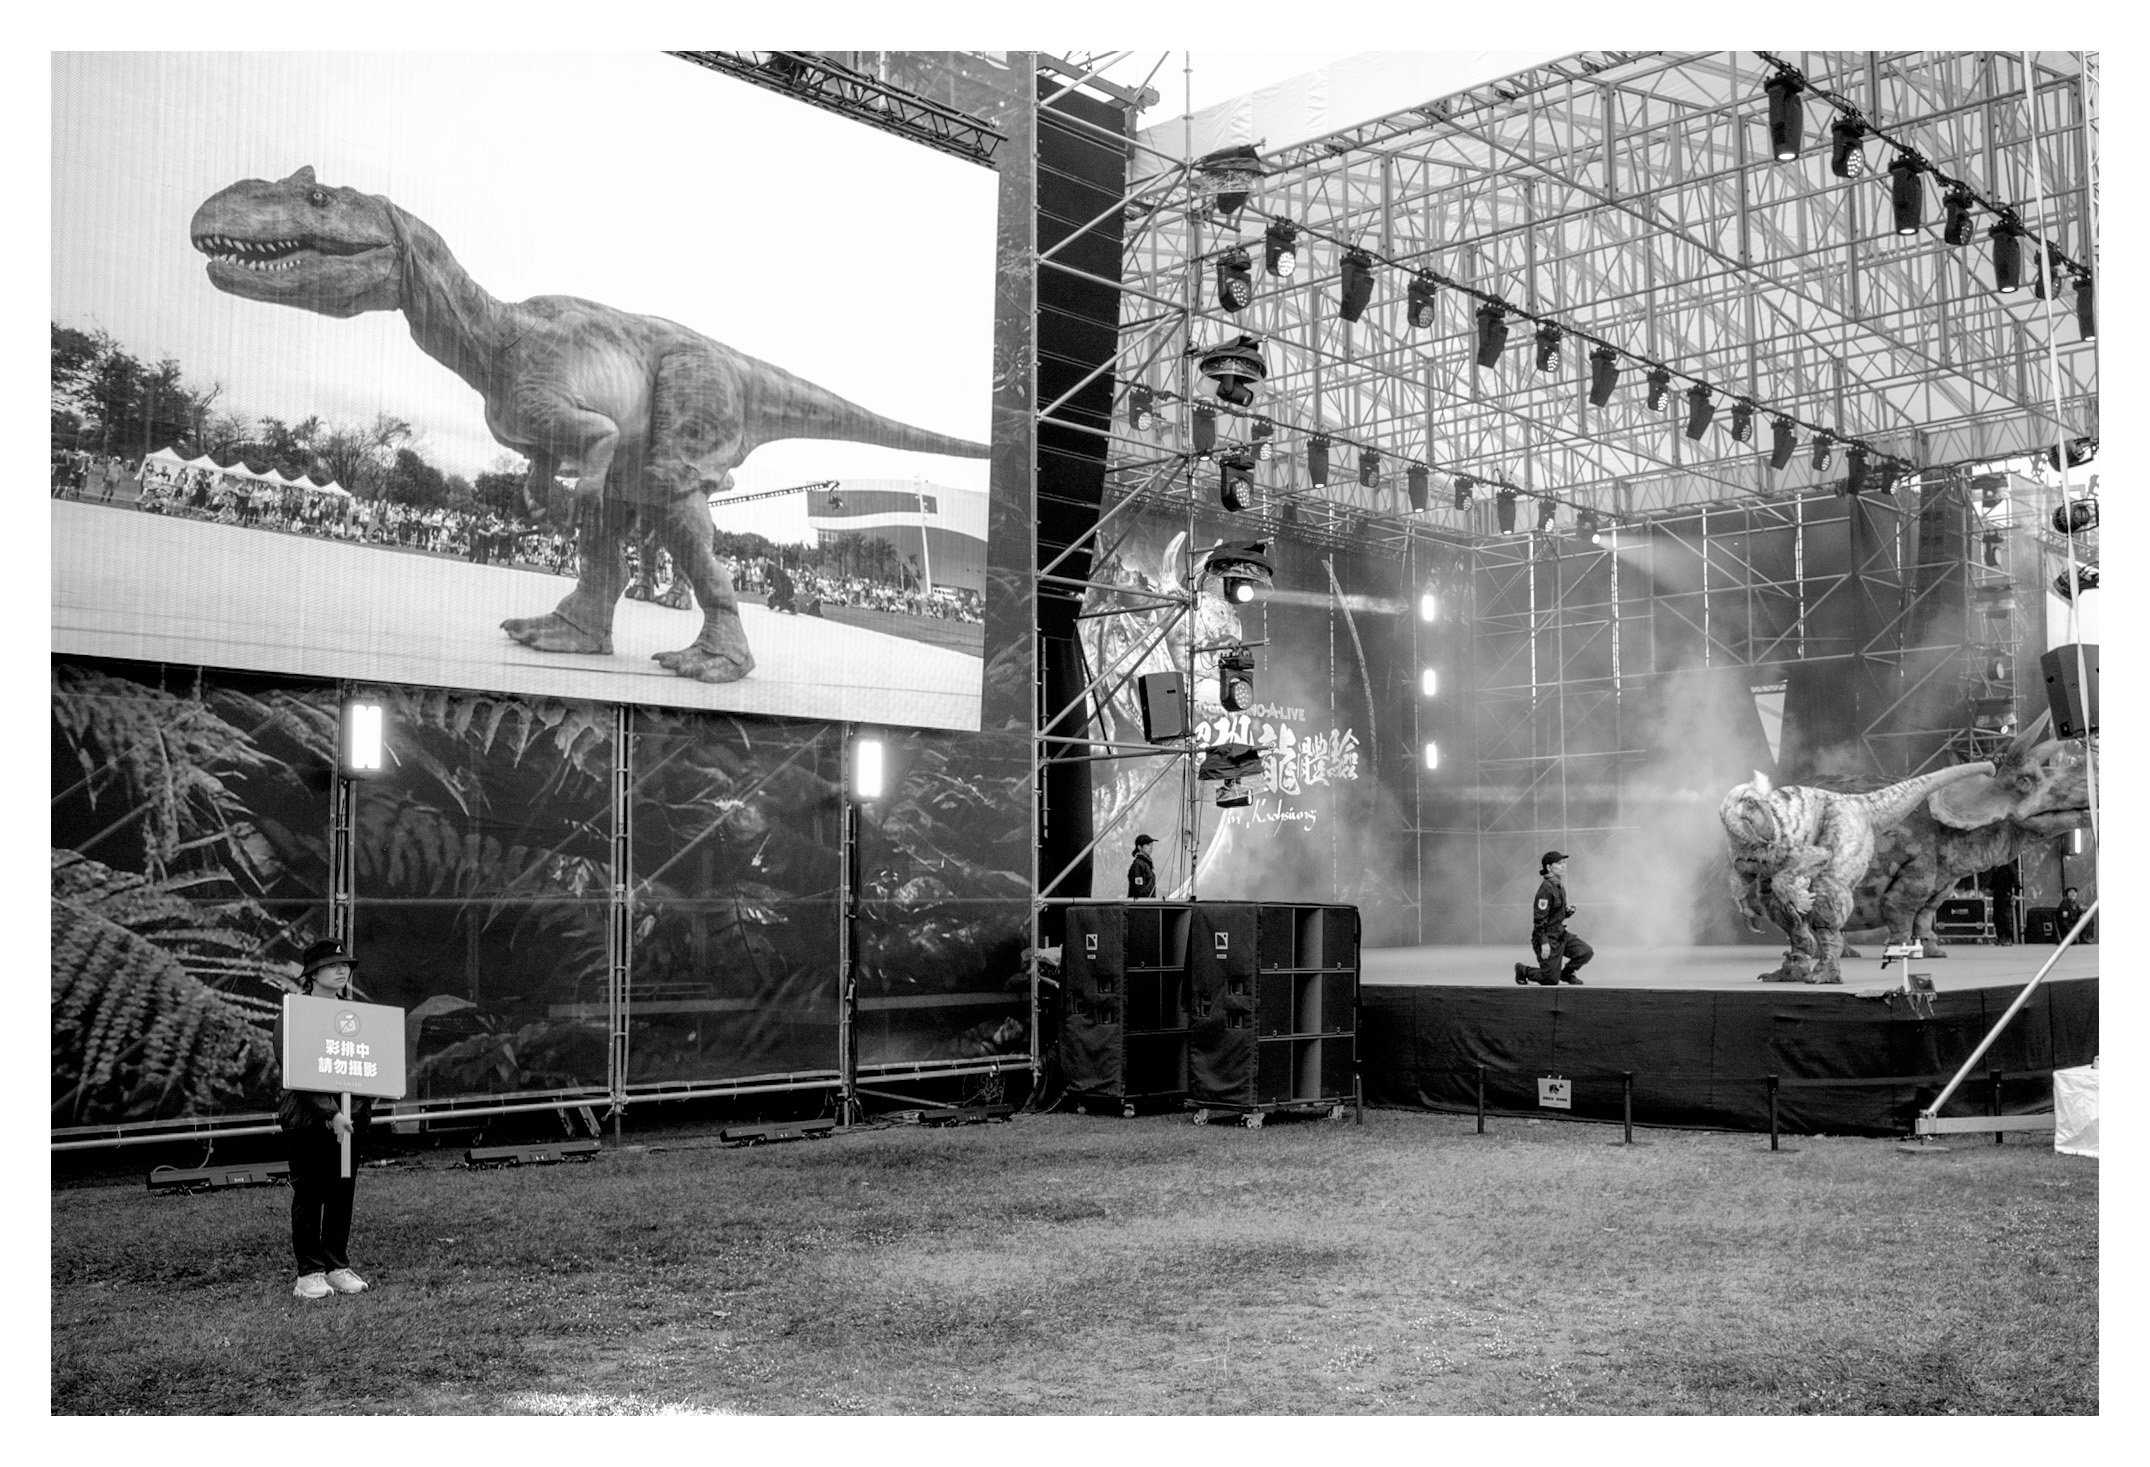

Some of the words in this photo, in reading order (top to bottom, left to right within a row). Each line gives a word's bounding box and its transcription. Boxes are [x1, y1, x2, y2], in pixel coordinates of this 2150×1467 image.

[325, 1039, 370, 1059] 彩排中
[318, 1056, 378, 1078] 請勿攝影
